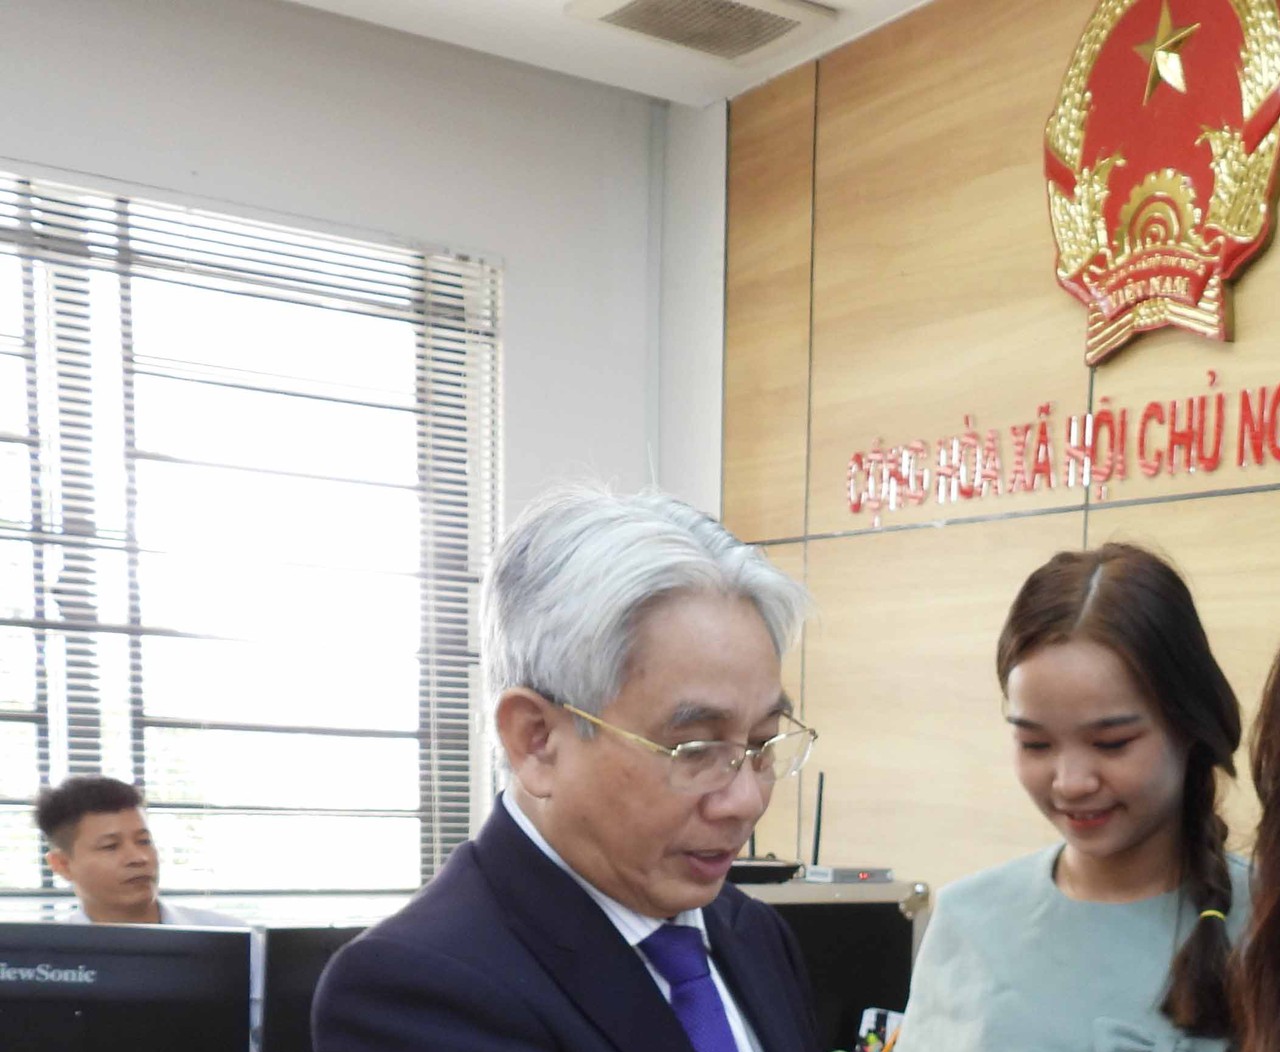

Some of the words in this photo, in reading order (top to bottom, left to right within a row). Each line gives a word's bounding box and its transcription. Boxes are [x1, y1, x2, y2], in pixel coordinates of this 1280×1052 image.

[935, 414, 1003, 505] HÒA
[1007, 402, 1057, 493] XÃ
[1066, 396, 1128, 501] HỘI
[1137, 370, 1225, 478] CHỦ
[0, 962, 97, 983] iewSonic
